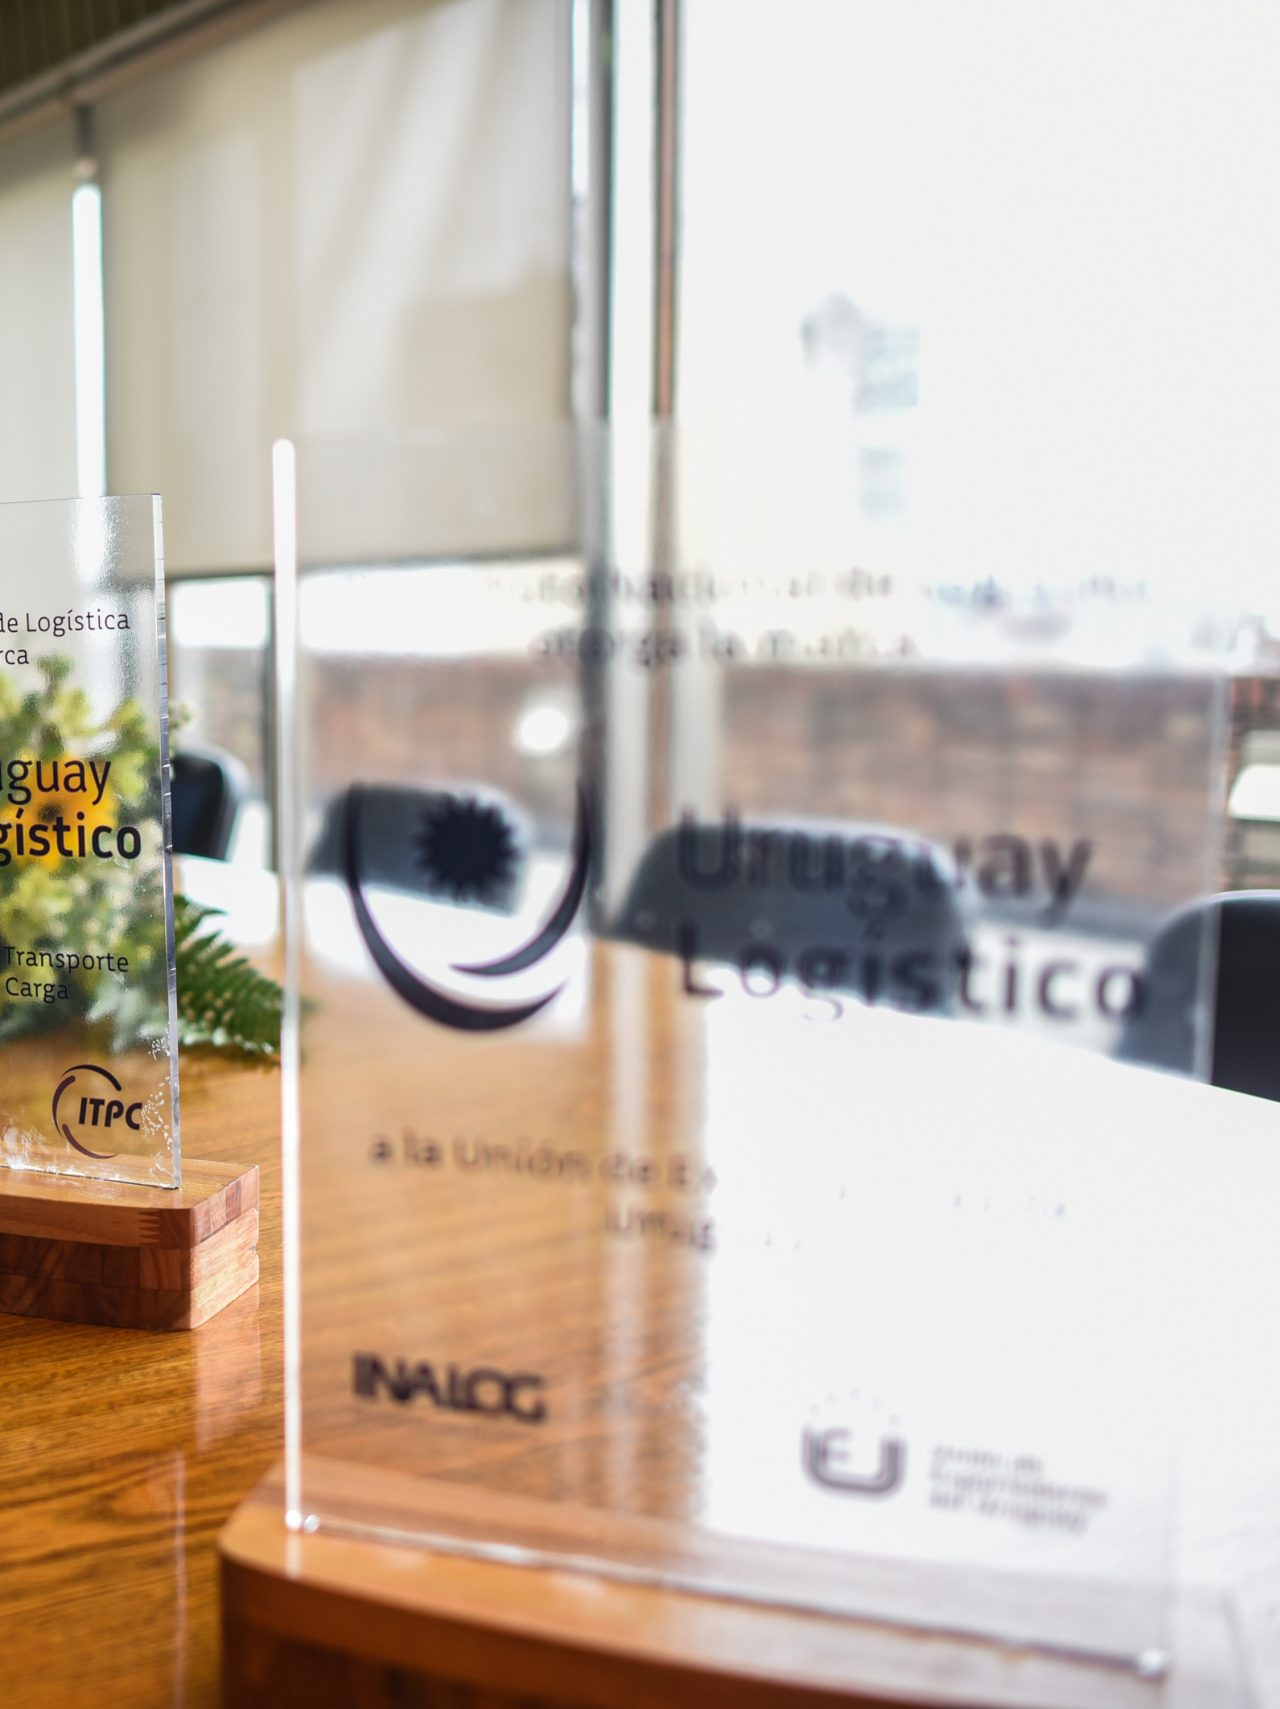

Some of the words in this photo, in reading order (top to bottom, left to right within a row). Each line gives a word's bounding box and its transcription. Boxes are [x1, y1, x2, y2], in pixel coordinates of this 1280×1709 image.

[26, 608, 130, 637] Logística
[677, 806, 1094, 926] Uruguay
[4, 946, 129, 973] Transporte
[678, 920, 1145, 1022] Logístico
[6, 977, 70, 1004] Carga
[78, 1097, 143, 1131] ITPC
[352, 1351, 548, 1425] INALOG
